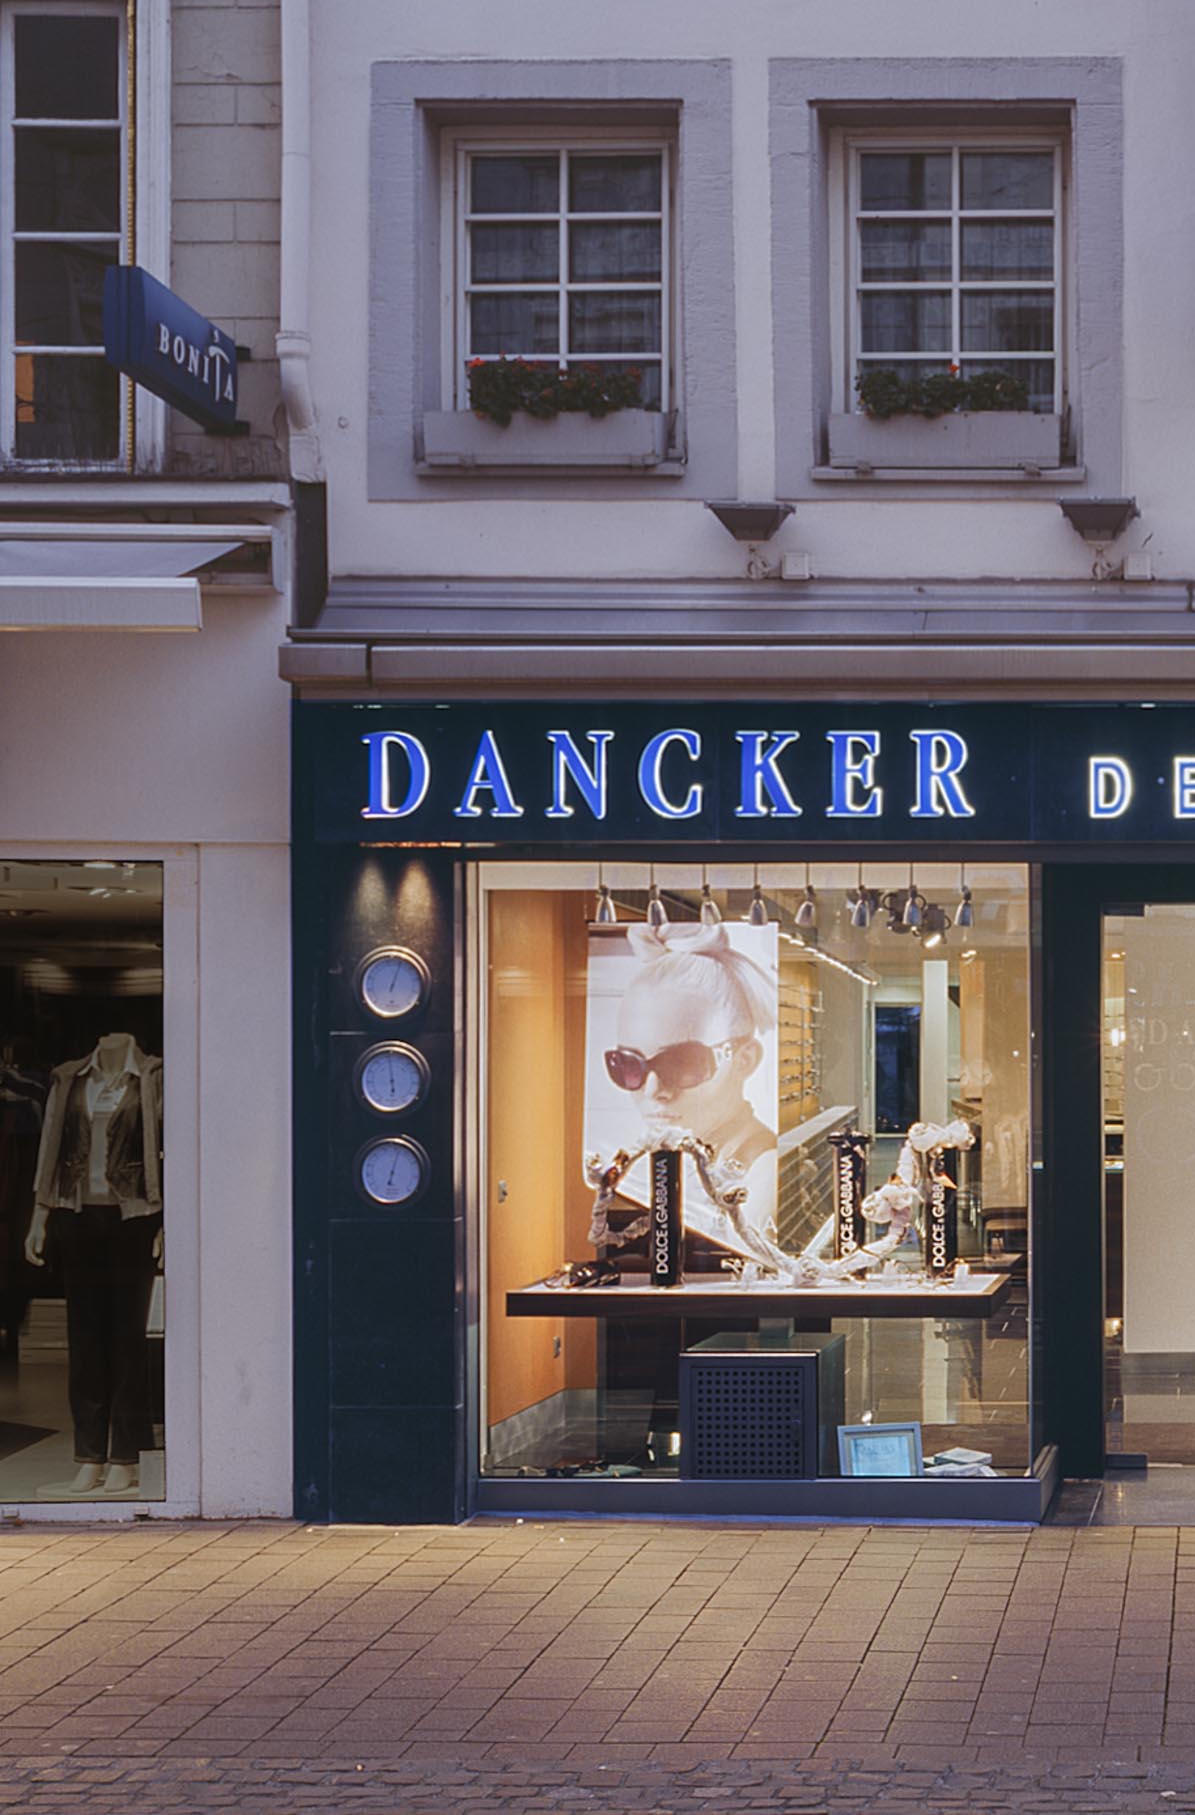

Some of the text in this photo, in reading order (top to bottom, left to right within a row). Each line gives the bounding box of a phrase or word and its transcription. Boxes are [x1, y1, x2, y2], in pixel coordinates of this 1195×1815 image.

[159, 323, 234, 402] BONITA
[360, 727, 976, 819] DANCKER
[656, 1158, 668, 1223] GABBANA
[656, 1229, 668, 1274] DOLCE
[840, 1223, 853, 1256] OLCE
[932, 1224, 945, 1268] DOLCE
